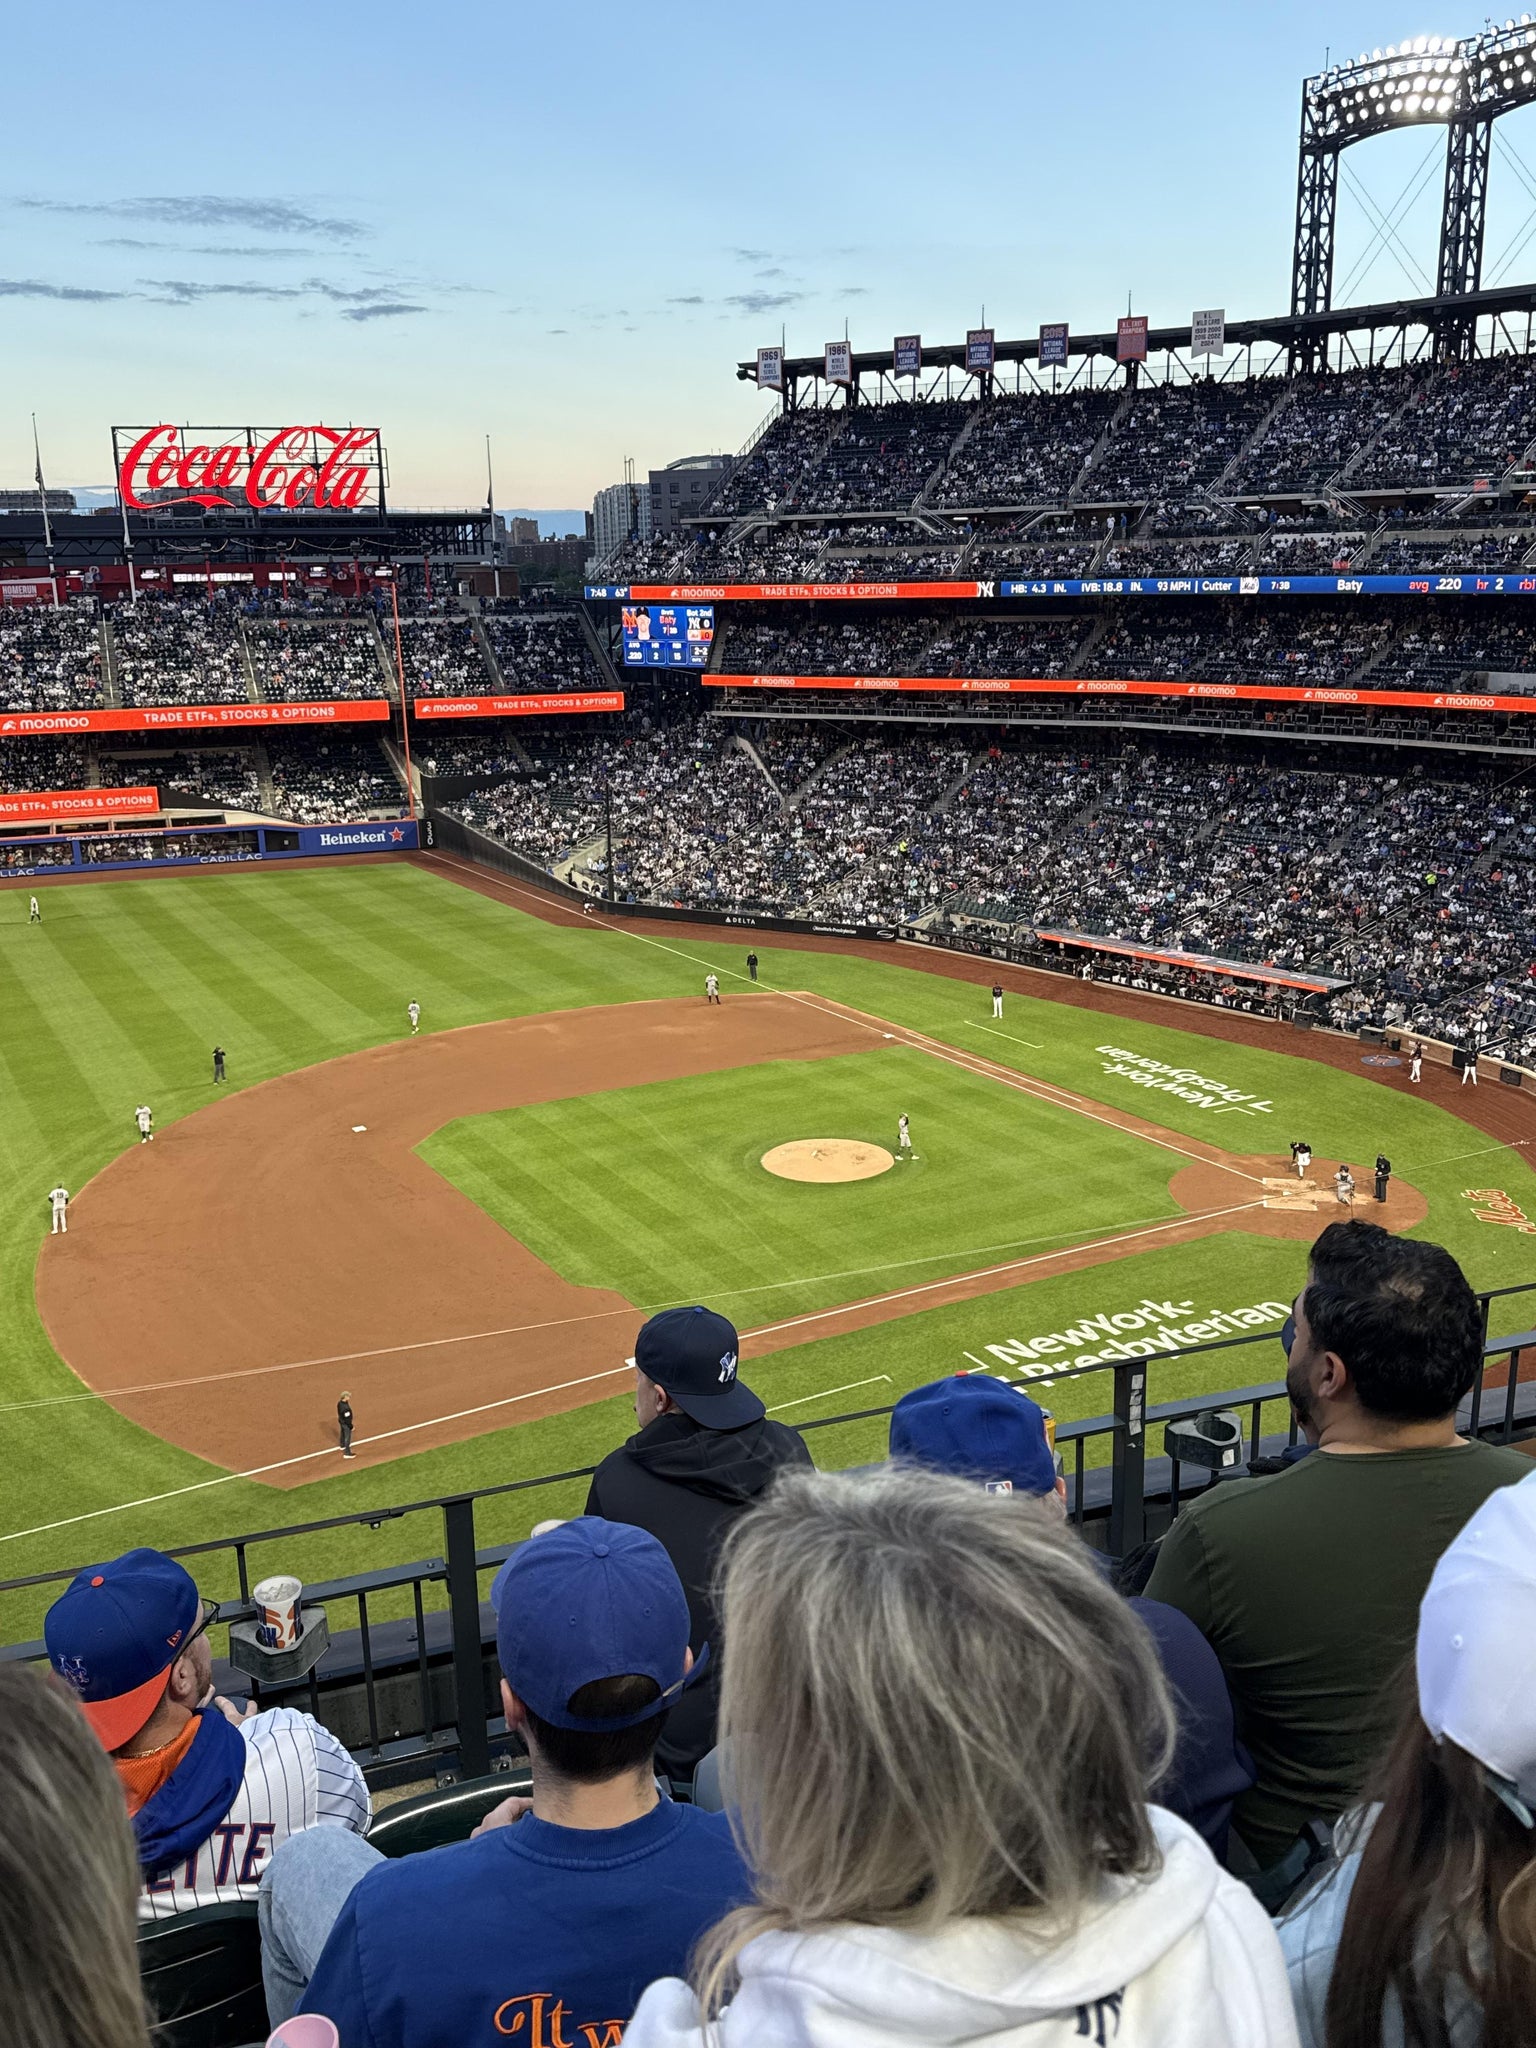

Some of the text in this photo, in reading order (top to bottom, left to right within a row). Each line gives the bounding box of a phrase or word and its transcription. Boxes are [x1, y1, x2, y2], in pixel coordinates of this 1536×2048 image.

[1043, 327, 1064, 338] 2015
[1120, 327, 1145, 335] CHAMPIONS
[968, 333, 992, 344] 2000
[761, 351, 778, 360] 1969
[829, 345, 847, 356] 1986
[1041, 352, 1065, 360] CHAMPIONS
[1010, 583, 1067, 593] HB: 4.3 IN.
[1081, 582, 1142, 592] IVB: 18.8 IN.
[1157, 582, 1168, 592] 93
[1170, 582, 1191, 591] MPH
[1202, 581, 1232, 591] Cutter
[1337, 579, 1363, 593] Baty
[1409, 578, 1536, 592] avg .220 hr 2 rbi
[590, 588, 607, 597] 7:48
[681, 588, 725, 597] moomoo
[760, 588, 788, 596] TRADE
[812, 587, 848, 596] STOCKS
[850, 587, 856, 595] &
[858, 586, 898, 595] OPTIONS
[660, 616, 676, 626] Baty
[654, 652, 659, 660] 2
[761, 678, 795, 686] moomoo
[862, 680, 899, 688] moomoo
[971, 681, 1010, 690] moomoo
[1087, 682, 1128, 691] moomoo
[1197, 686, 1236, 695] moomoo
[1314, 691, 1358, 700] moomoo
[542, 699, 574, 708] STOCKS
[582, 697, 618, 706] OPTIONS
[1446, 696, 1495, 708] moomoo
[433, 703, 478, 712] moomoo
[143, 706, 336, 723] TRADE ETFs, STOCKS & OPTIONS
[20, 716, 90, 730] moomoo
[22, 802, 50, 811] ETFs,
[52, 798, 94, 809] STOCKS
[97, 798, 104, 806] &
[106, 796, 154, 806] OPTIONS
[320, 830, 385, 846] Heineken
[200, 853, 263, 864] CADILLAC
[0, 868, 35, 877] LLAC
[732, 917, 756, 925] DELTA
[1095, 1046, 1257, 1102] Presbyterian
[1018, 1300, 1293, 1387] Presbyterian
